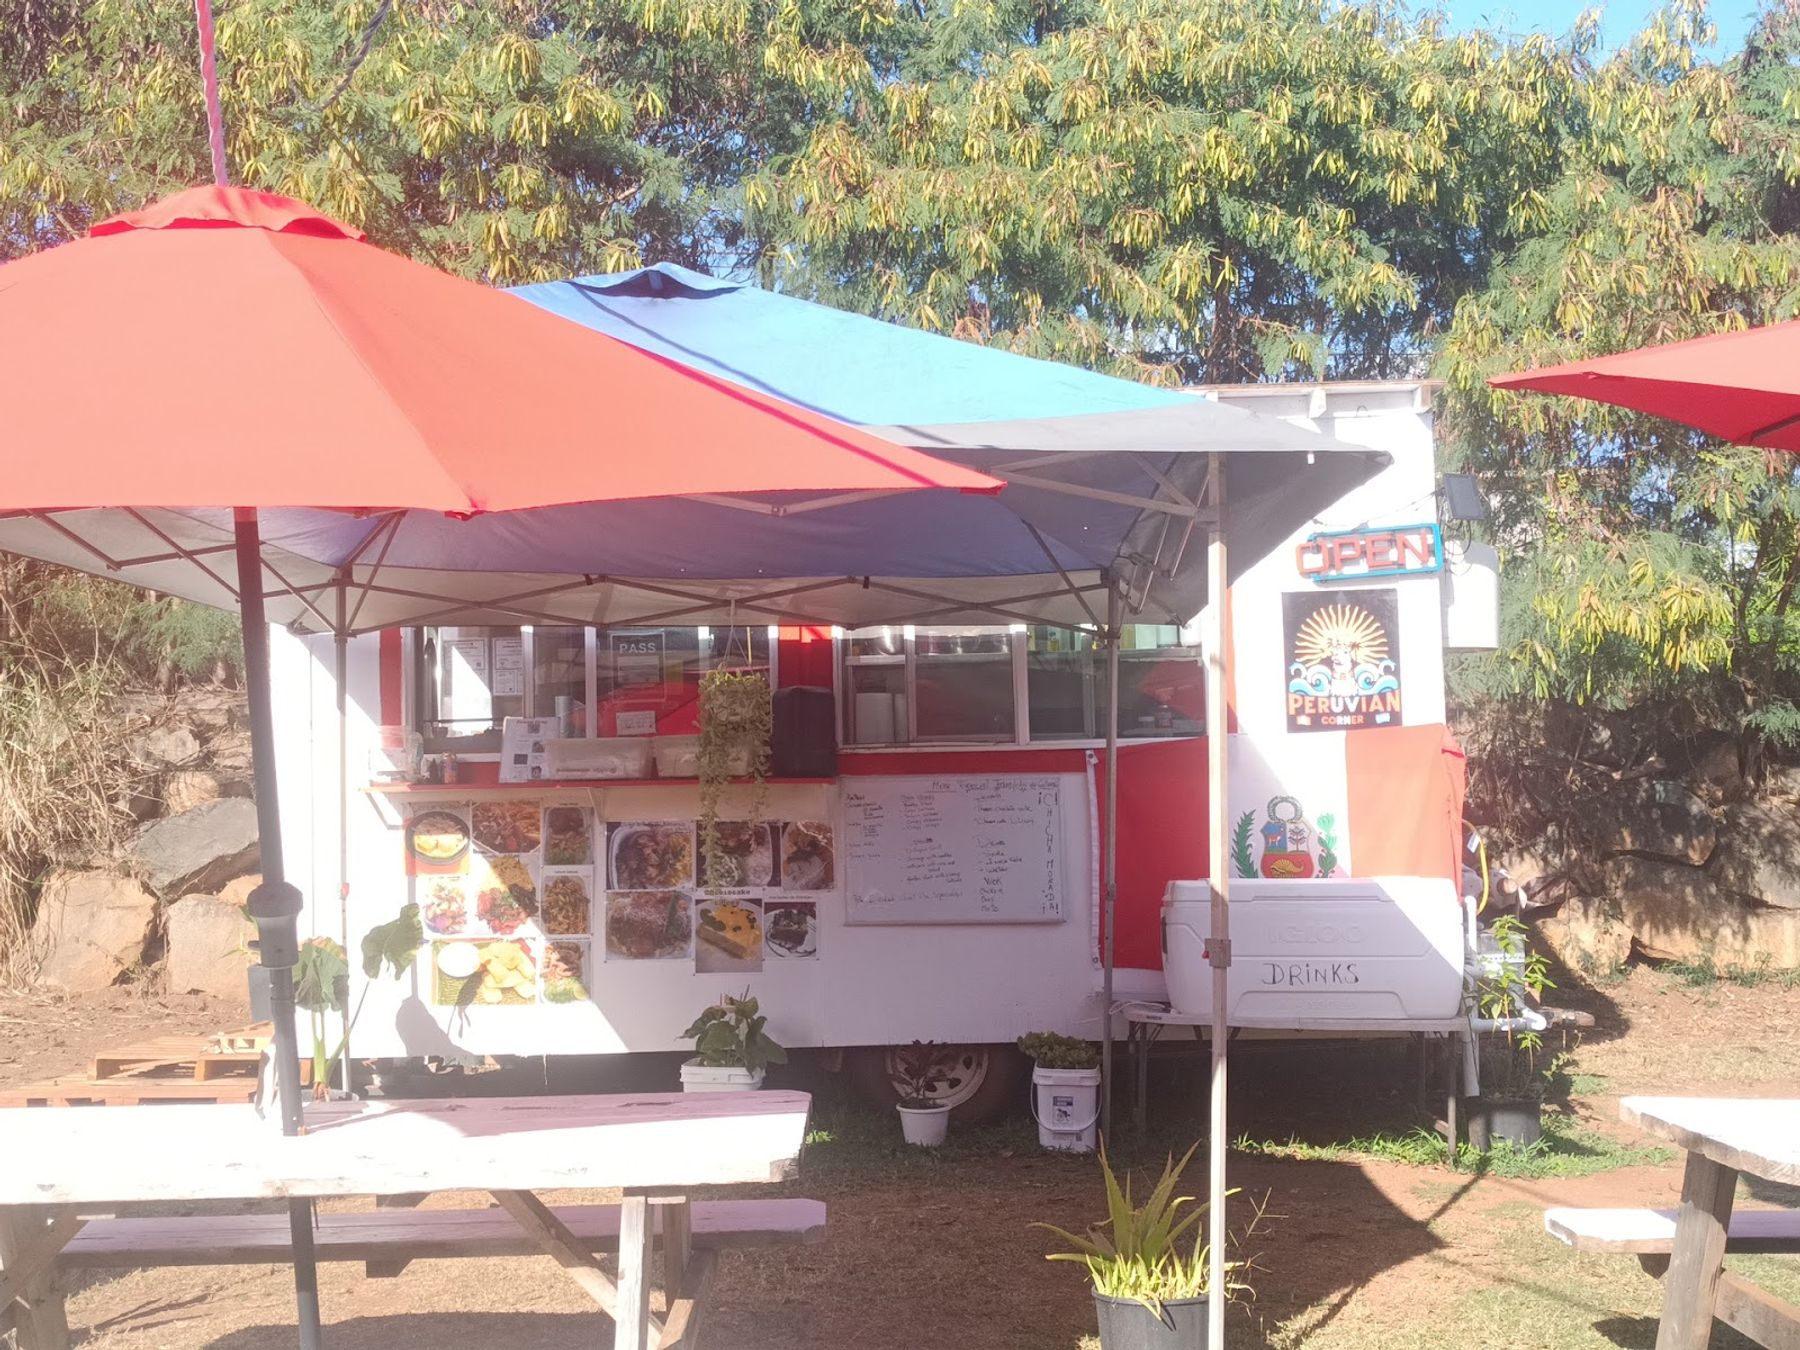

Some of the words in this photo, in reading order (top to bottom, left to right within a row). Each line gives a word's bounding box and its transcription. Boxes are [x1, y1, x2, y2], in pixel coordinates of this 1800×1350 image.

[1296, 529, 1430, 579] OPEN
[619, 642, 657, 654] PASS
[1288, 690, 1401, 715] PERUVIAN
[1321, 715, 1364, 725] CORNER
